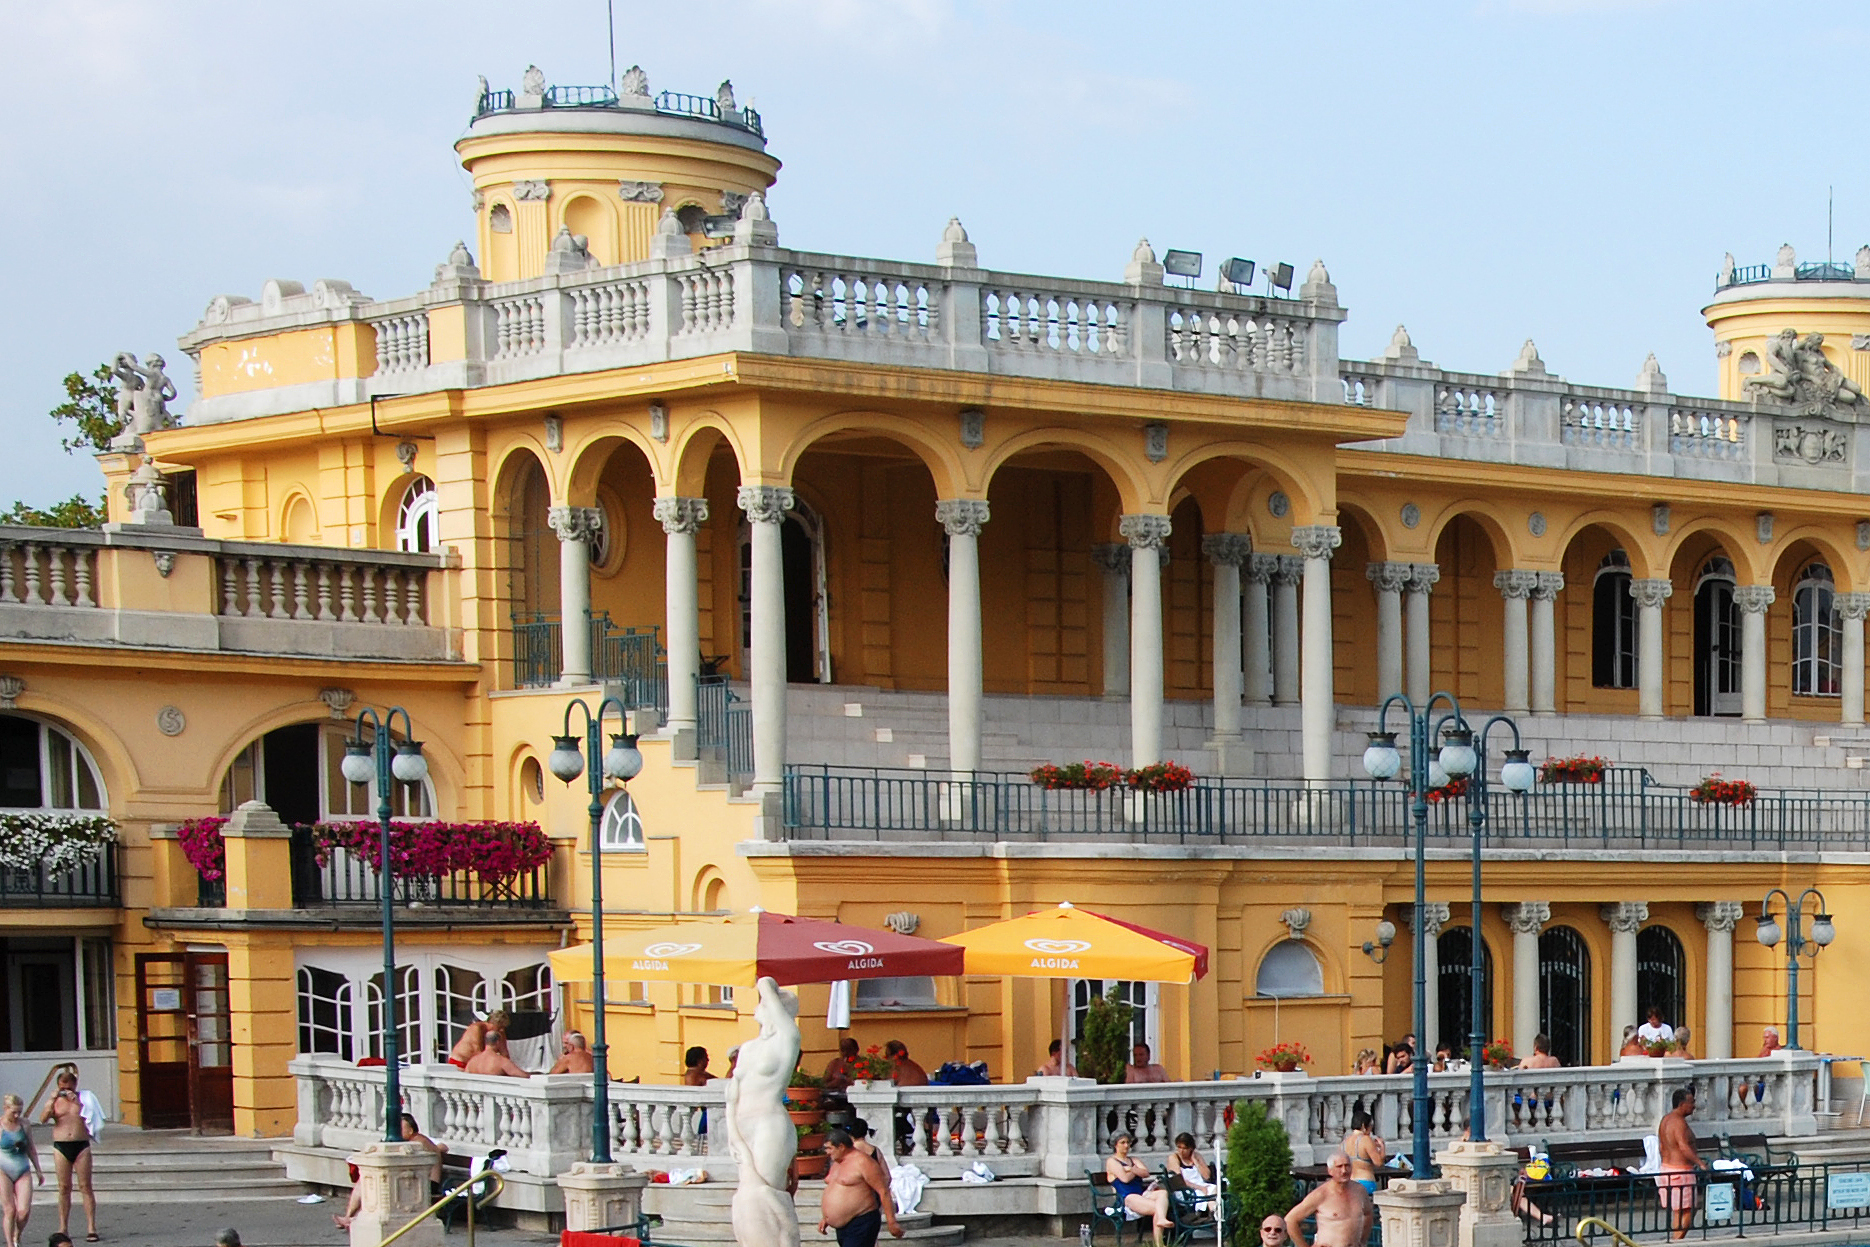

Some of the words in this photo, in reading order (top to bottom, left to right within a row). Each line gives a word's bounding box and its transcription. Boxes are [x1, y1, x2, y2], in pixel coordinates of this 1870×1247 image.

[632, 959, 669, 971] ALGIDA
[848, 957, 883, 970] ALGIDA
[1030, 958, 1079, 969] ALGIDA
